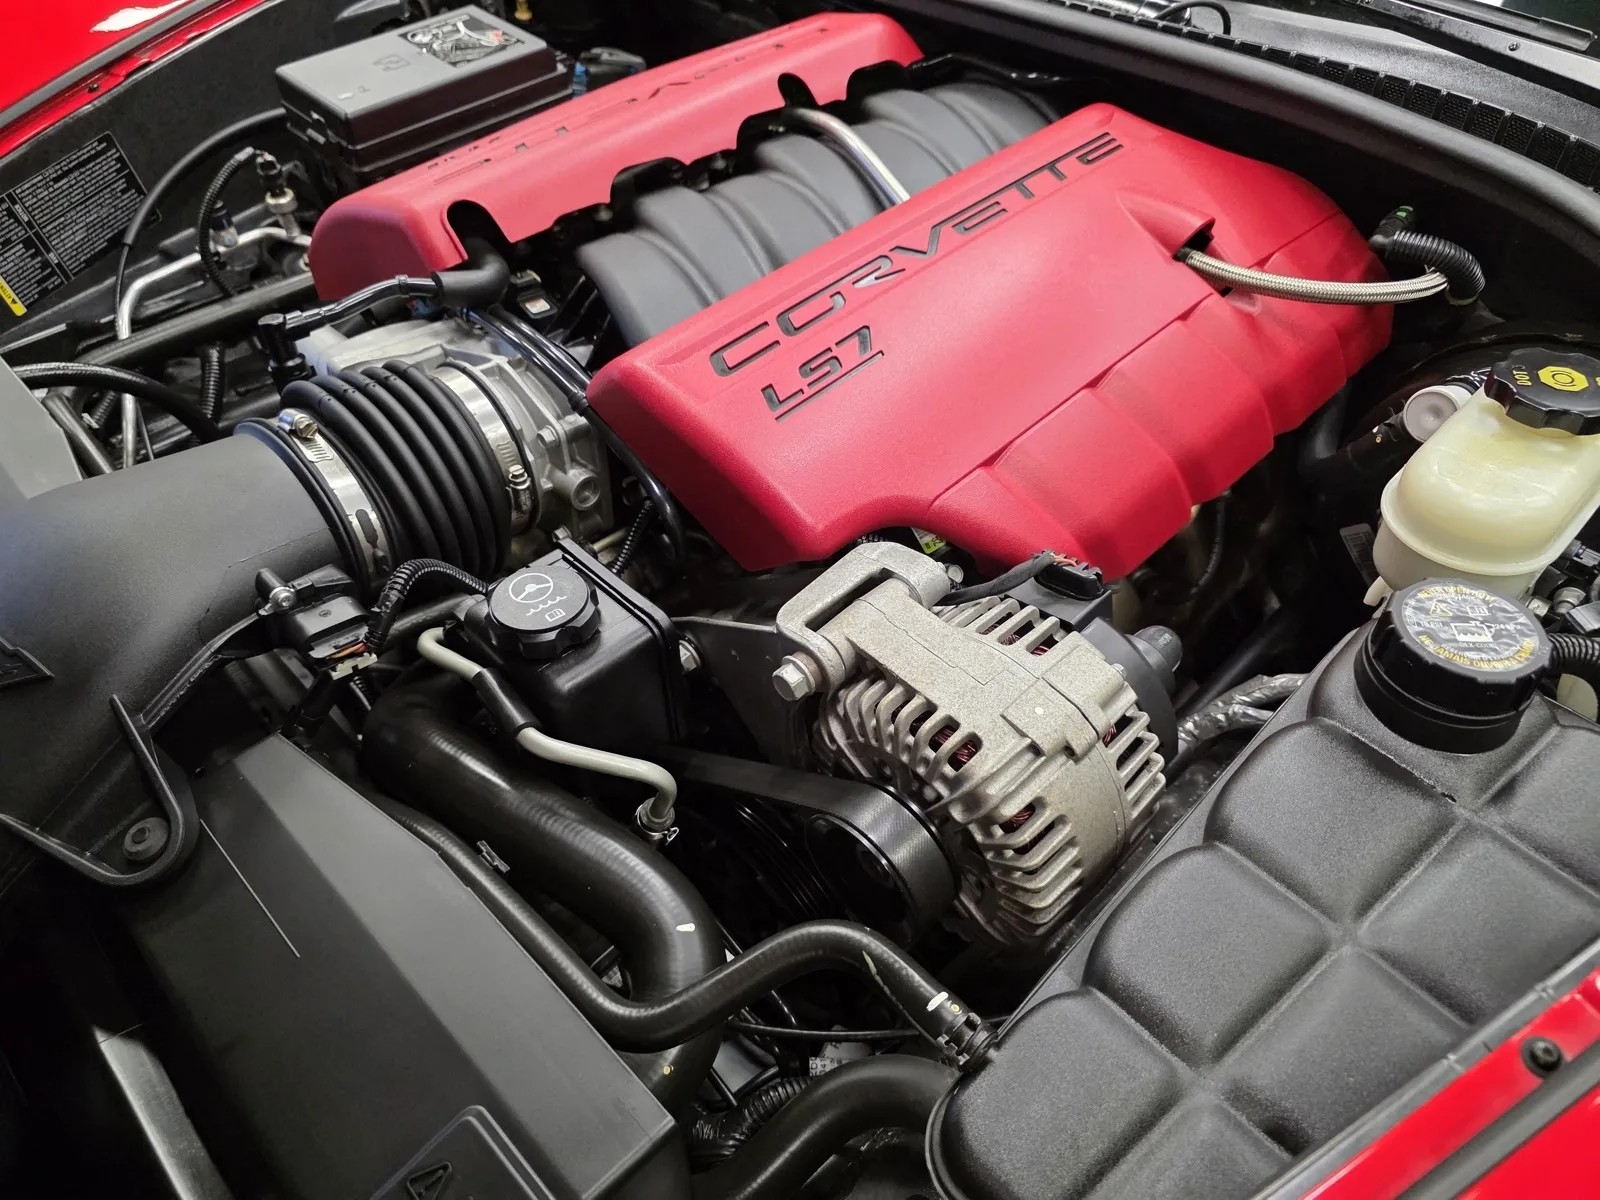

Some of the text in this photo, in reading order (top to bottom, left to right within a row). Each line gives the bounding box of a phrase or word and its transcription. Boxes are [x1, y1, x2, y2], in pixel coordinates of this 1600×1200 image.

[709, 131, 1125, 377] CORVETTE
[760, 324, 875, 413] LS7
[1513, 370, 1532, 386] DOT
[1434, 645, 1471, 665] JAMAIS
